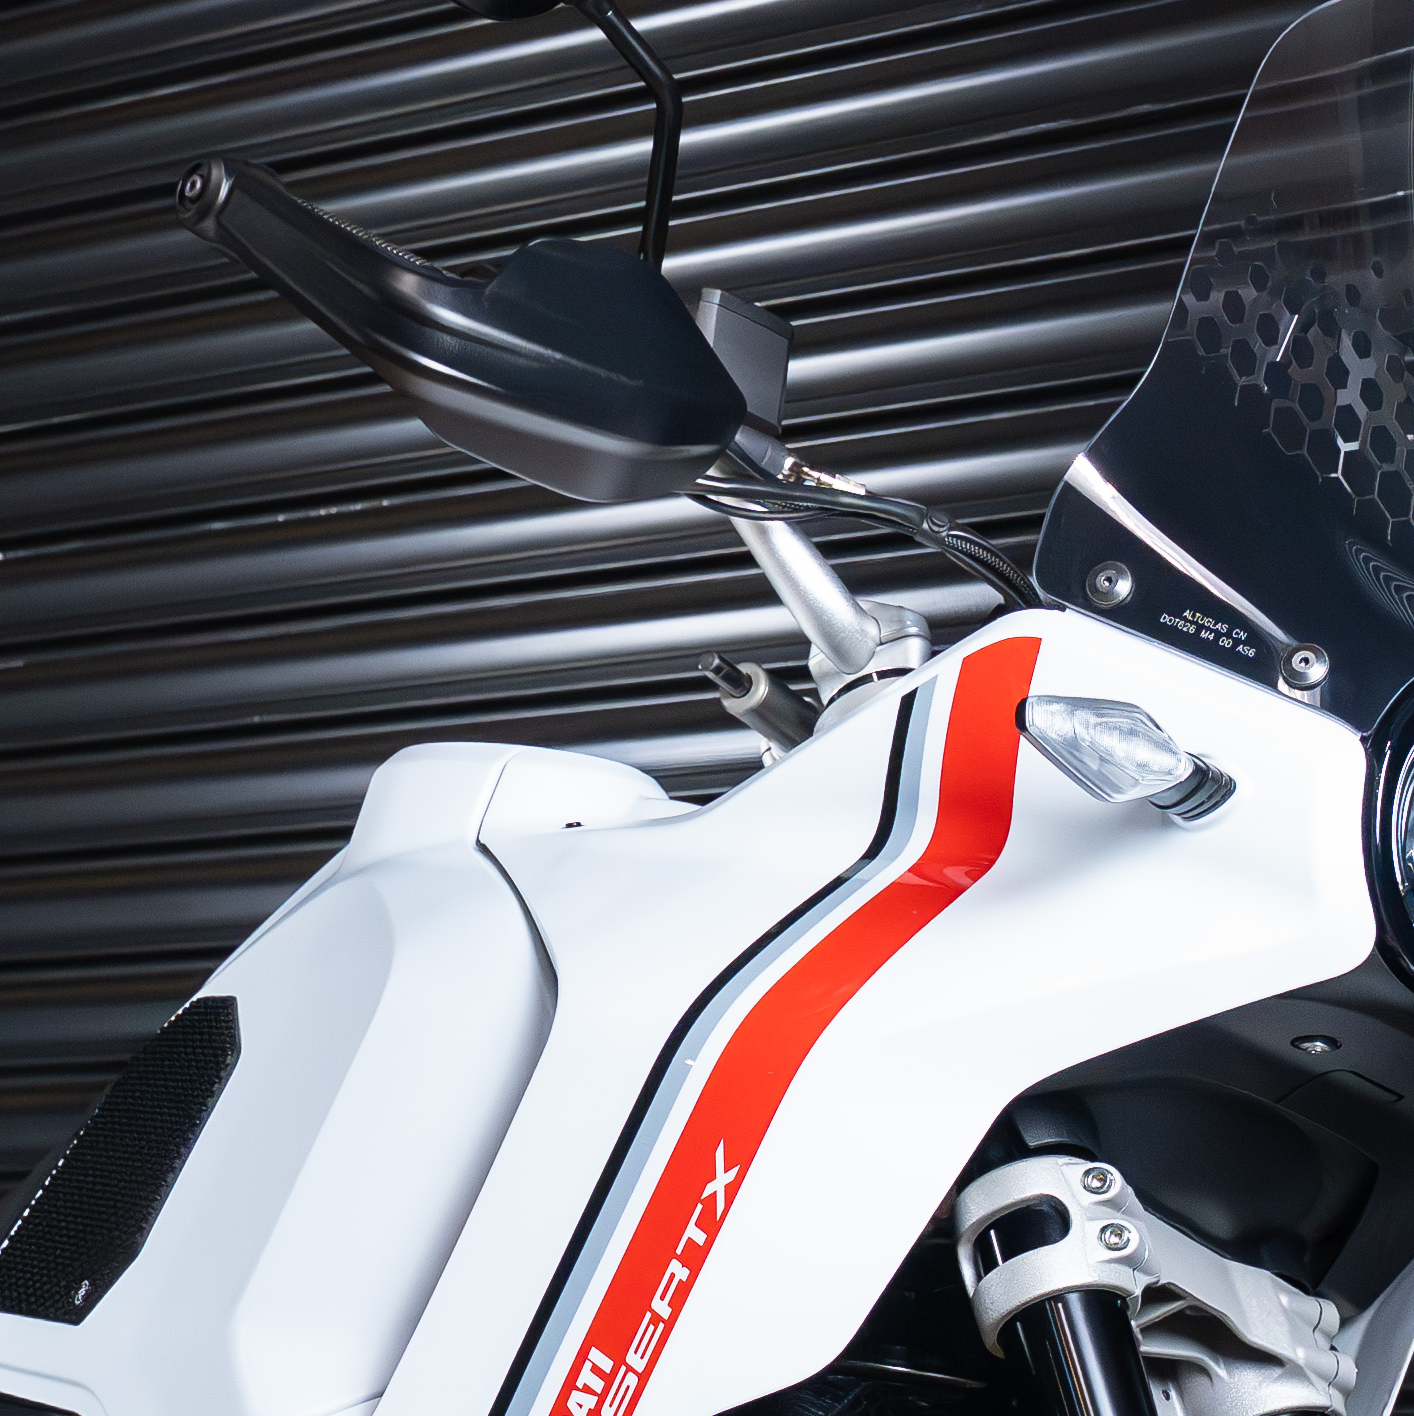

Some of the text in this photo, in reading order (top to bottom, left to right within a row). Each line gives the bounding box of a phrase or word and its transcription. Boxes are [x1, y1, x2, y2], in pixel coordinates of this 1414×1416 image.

[1159, 612, 1197, 634] DOT626
[1199, 629, 1215, 641] M4
[1235, 644, 1256, 658] AS6
[1182, 609, 1248, 641] ALTUGLAS CN
